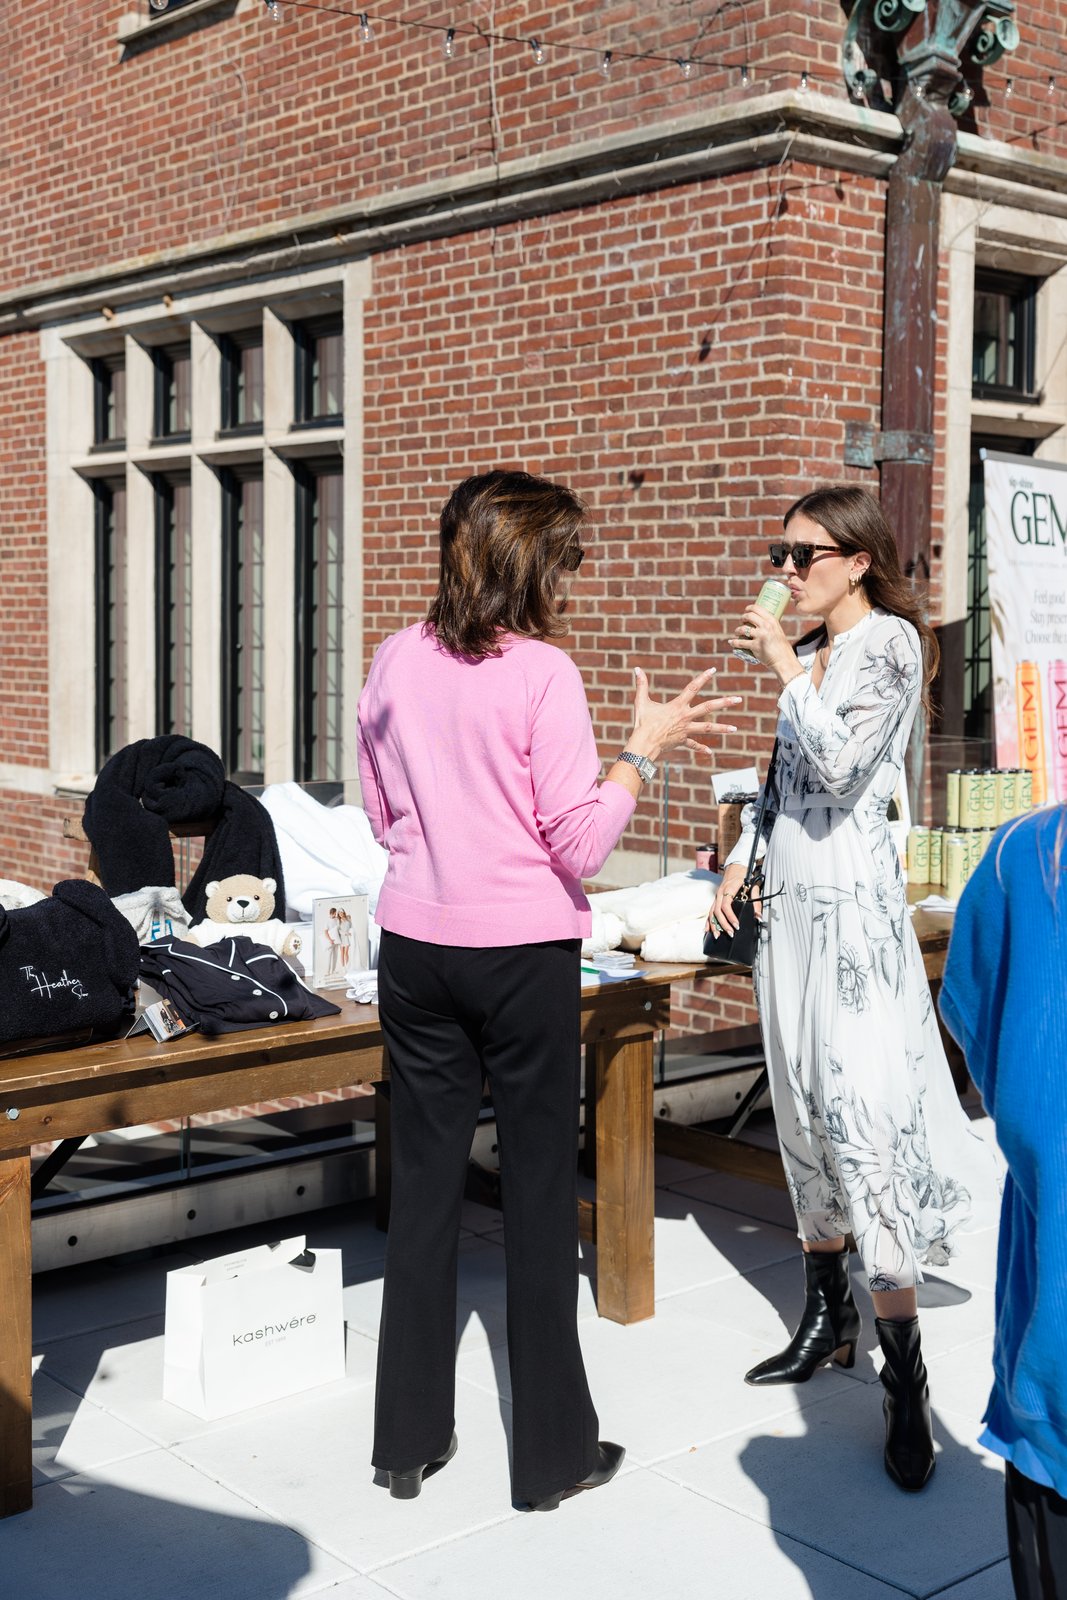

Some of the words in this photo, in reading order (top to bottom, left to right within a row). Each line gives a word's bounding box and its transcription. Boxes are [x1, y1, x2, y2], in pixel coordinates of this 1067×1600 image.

[1021, 680, 1039, 761] GEM
[969, 778, 982, 812] GEM
[983, 778, 996, 811] GEM
[1003, 777, 1016, 810] GEM
[916, 834, 929, 868] GEM
